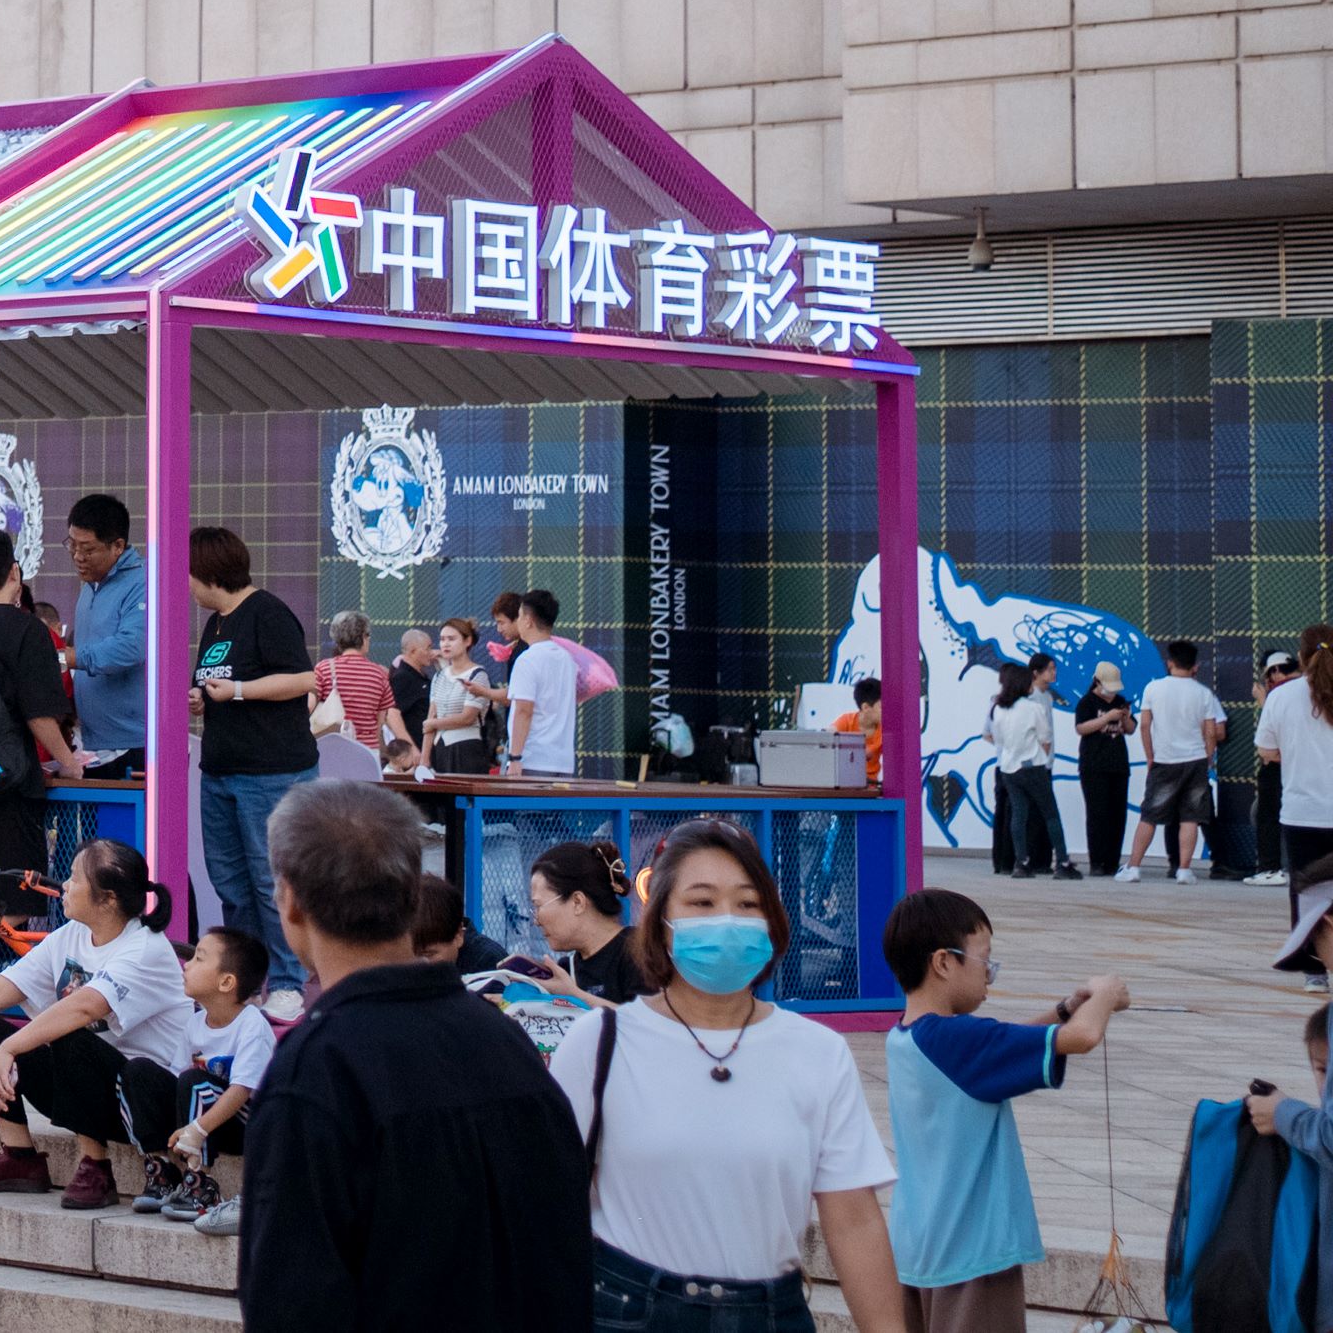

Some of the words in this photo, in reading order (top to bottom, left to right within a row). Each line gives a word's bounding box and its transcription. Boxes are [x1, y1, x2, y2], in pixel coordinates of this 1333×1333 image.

[360, 188, 881, 353] 中国体育彩票
[452, 475, 495, 495] AMAM
[498, 474, 568, 495] LONBAKERY
[571, 473, 609, 494] TOWN
[513, 498, 546, 511] LONDON
[650, 444, 671, 511] TOWN
[650, 524, 671, 661] LONBAKERY
[673, 568, 687, 631] LONDON
